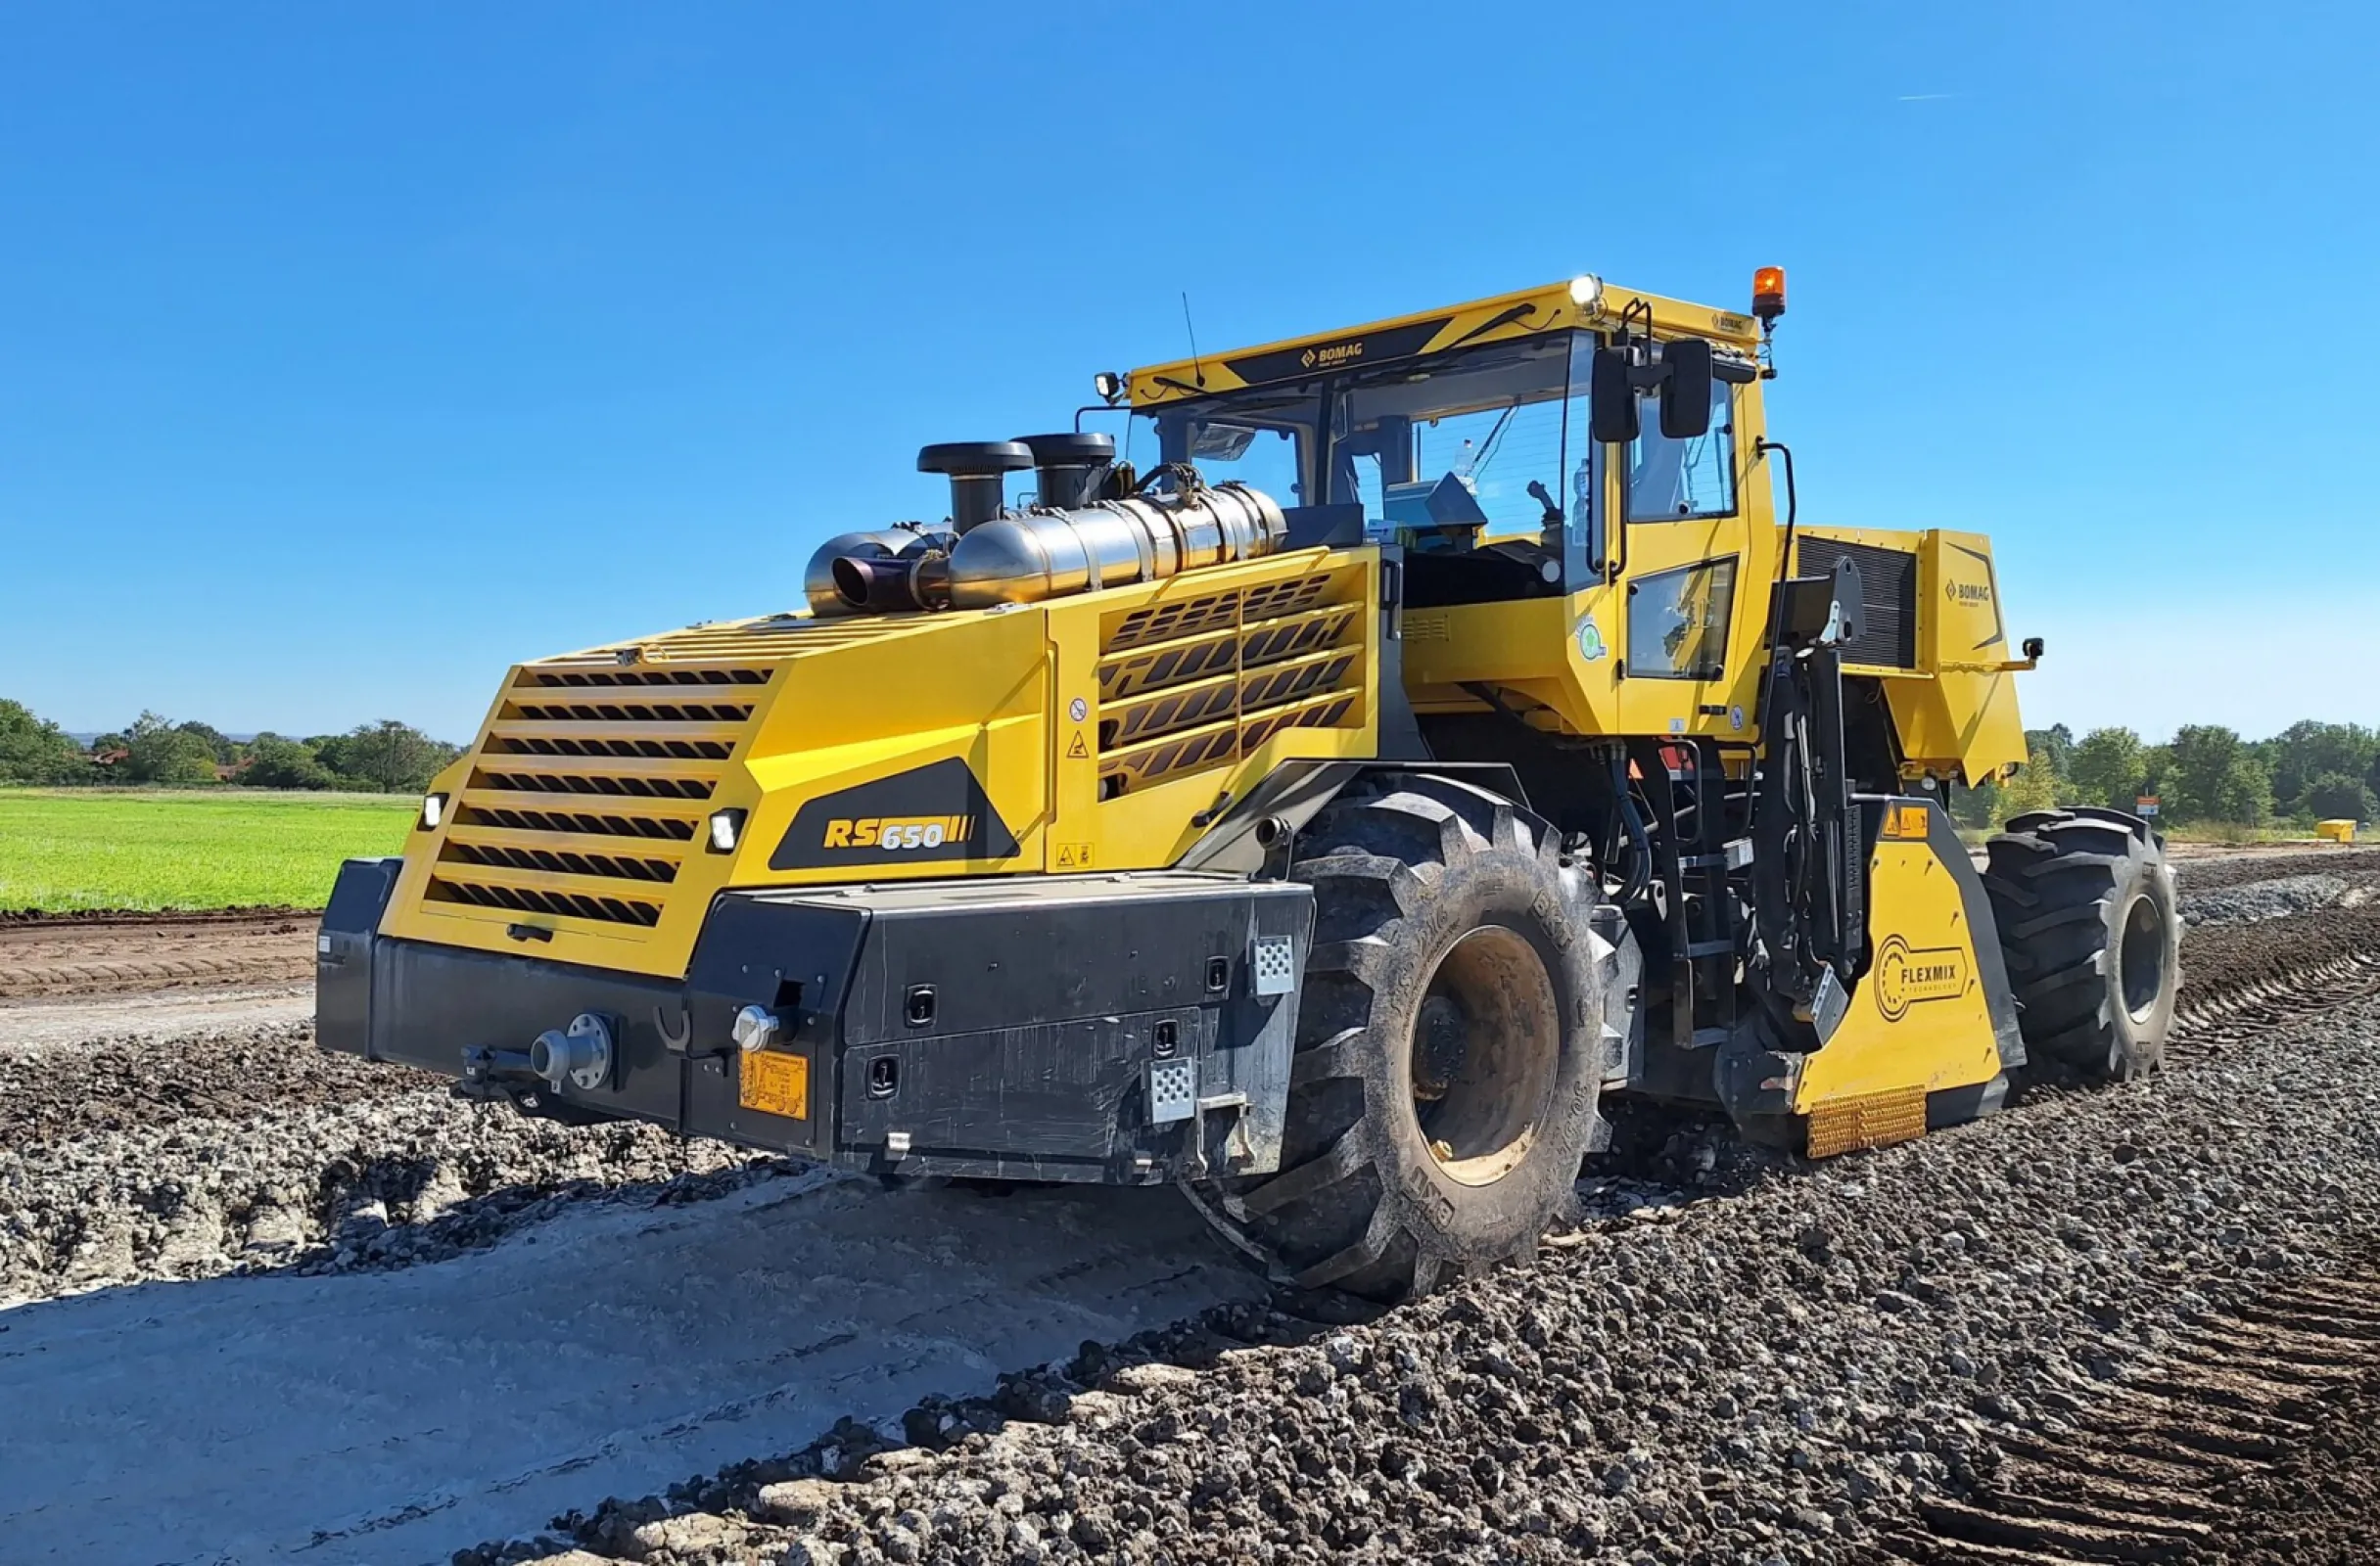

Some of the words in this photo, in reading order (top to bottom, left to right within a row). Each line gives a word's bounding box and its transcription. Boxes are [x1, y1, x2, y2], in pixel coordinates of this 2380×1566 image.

[1319, 343, 1363, 362] BOMAG
[1958, 583, 1988, 601] BOMAG
[1901, 965, 1956, 984] FLEXMIX
